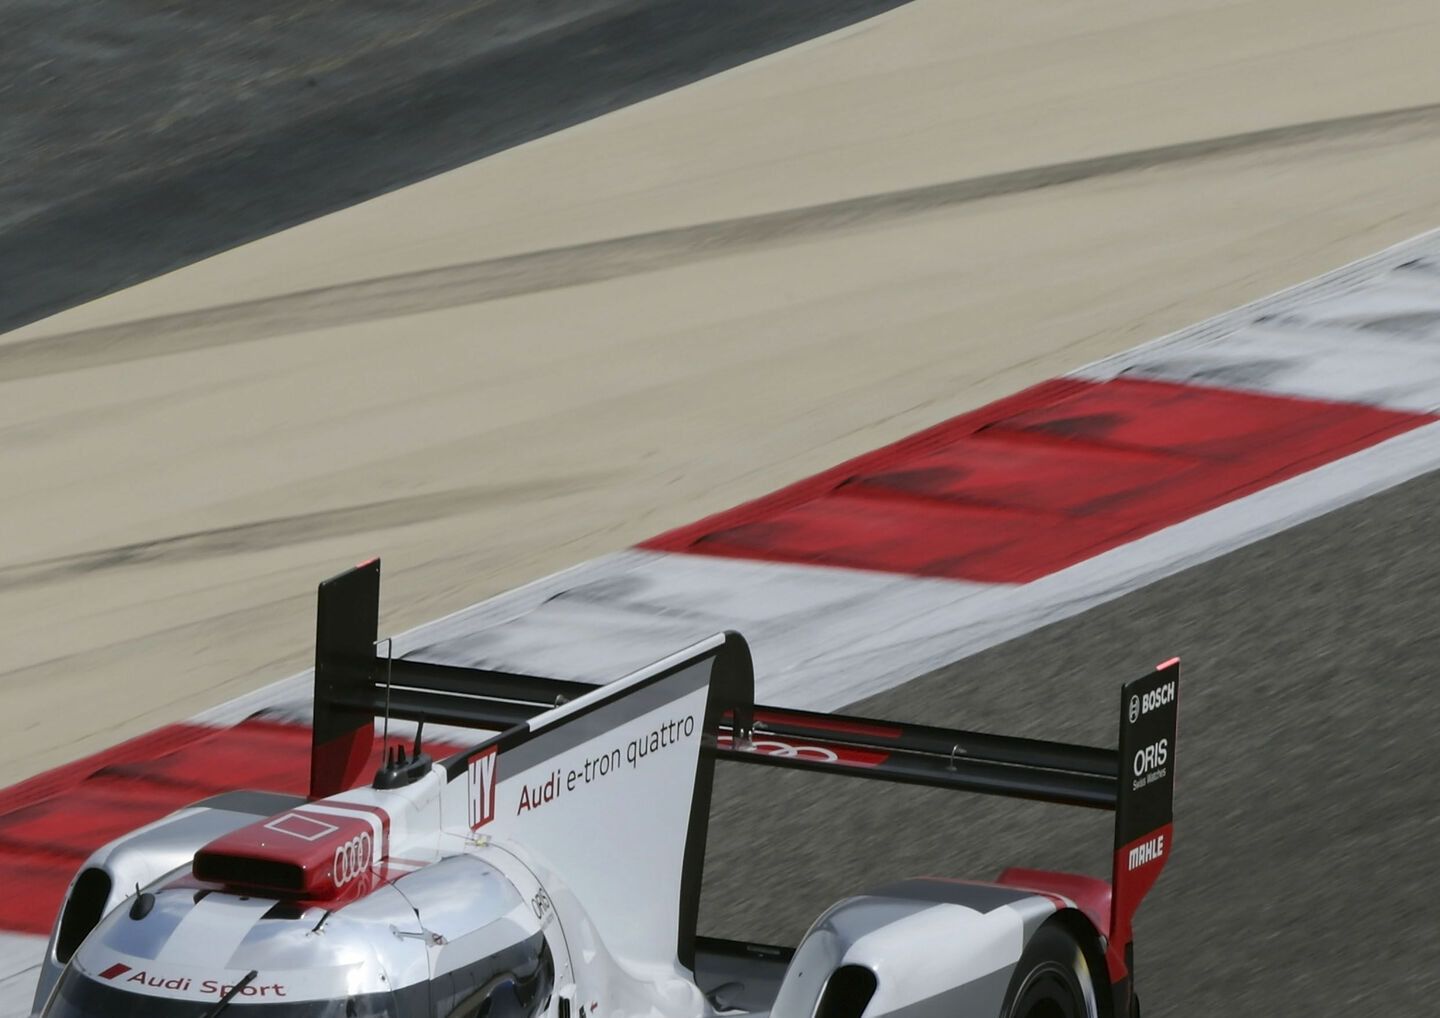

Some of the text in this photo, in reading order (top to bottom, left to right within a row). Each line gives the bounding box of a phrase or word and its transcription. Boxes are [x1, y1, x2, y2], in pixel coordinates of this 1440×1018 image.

[1142, 681, 1175, 715] BOSCH
[517, 715, 694, 816] Audi e-tron quattro
[1133, 738, 1168, 777] ORIS
[468, 752, 497, 830] HY
[1128, 835, 1164, 871] MAHLE
[127, 971, 287, 998] Audi Sport
